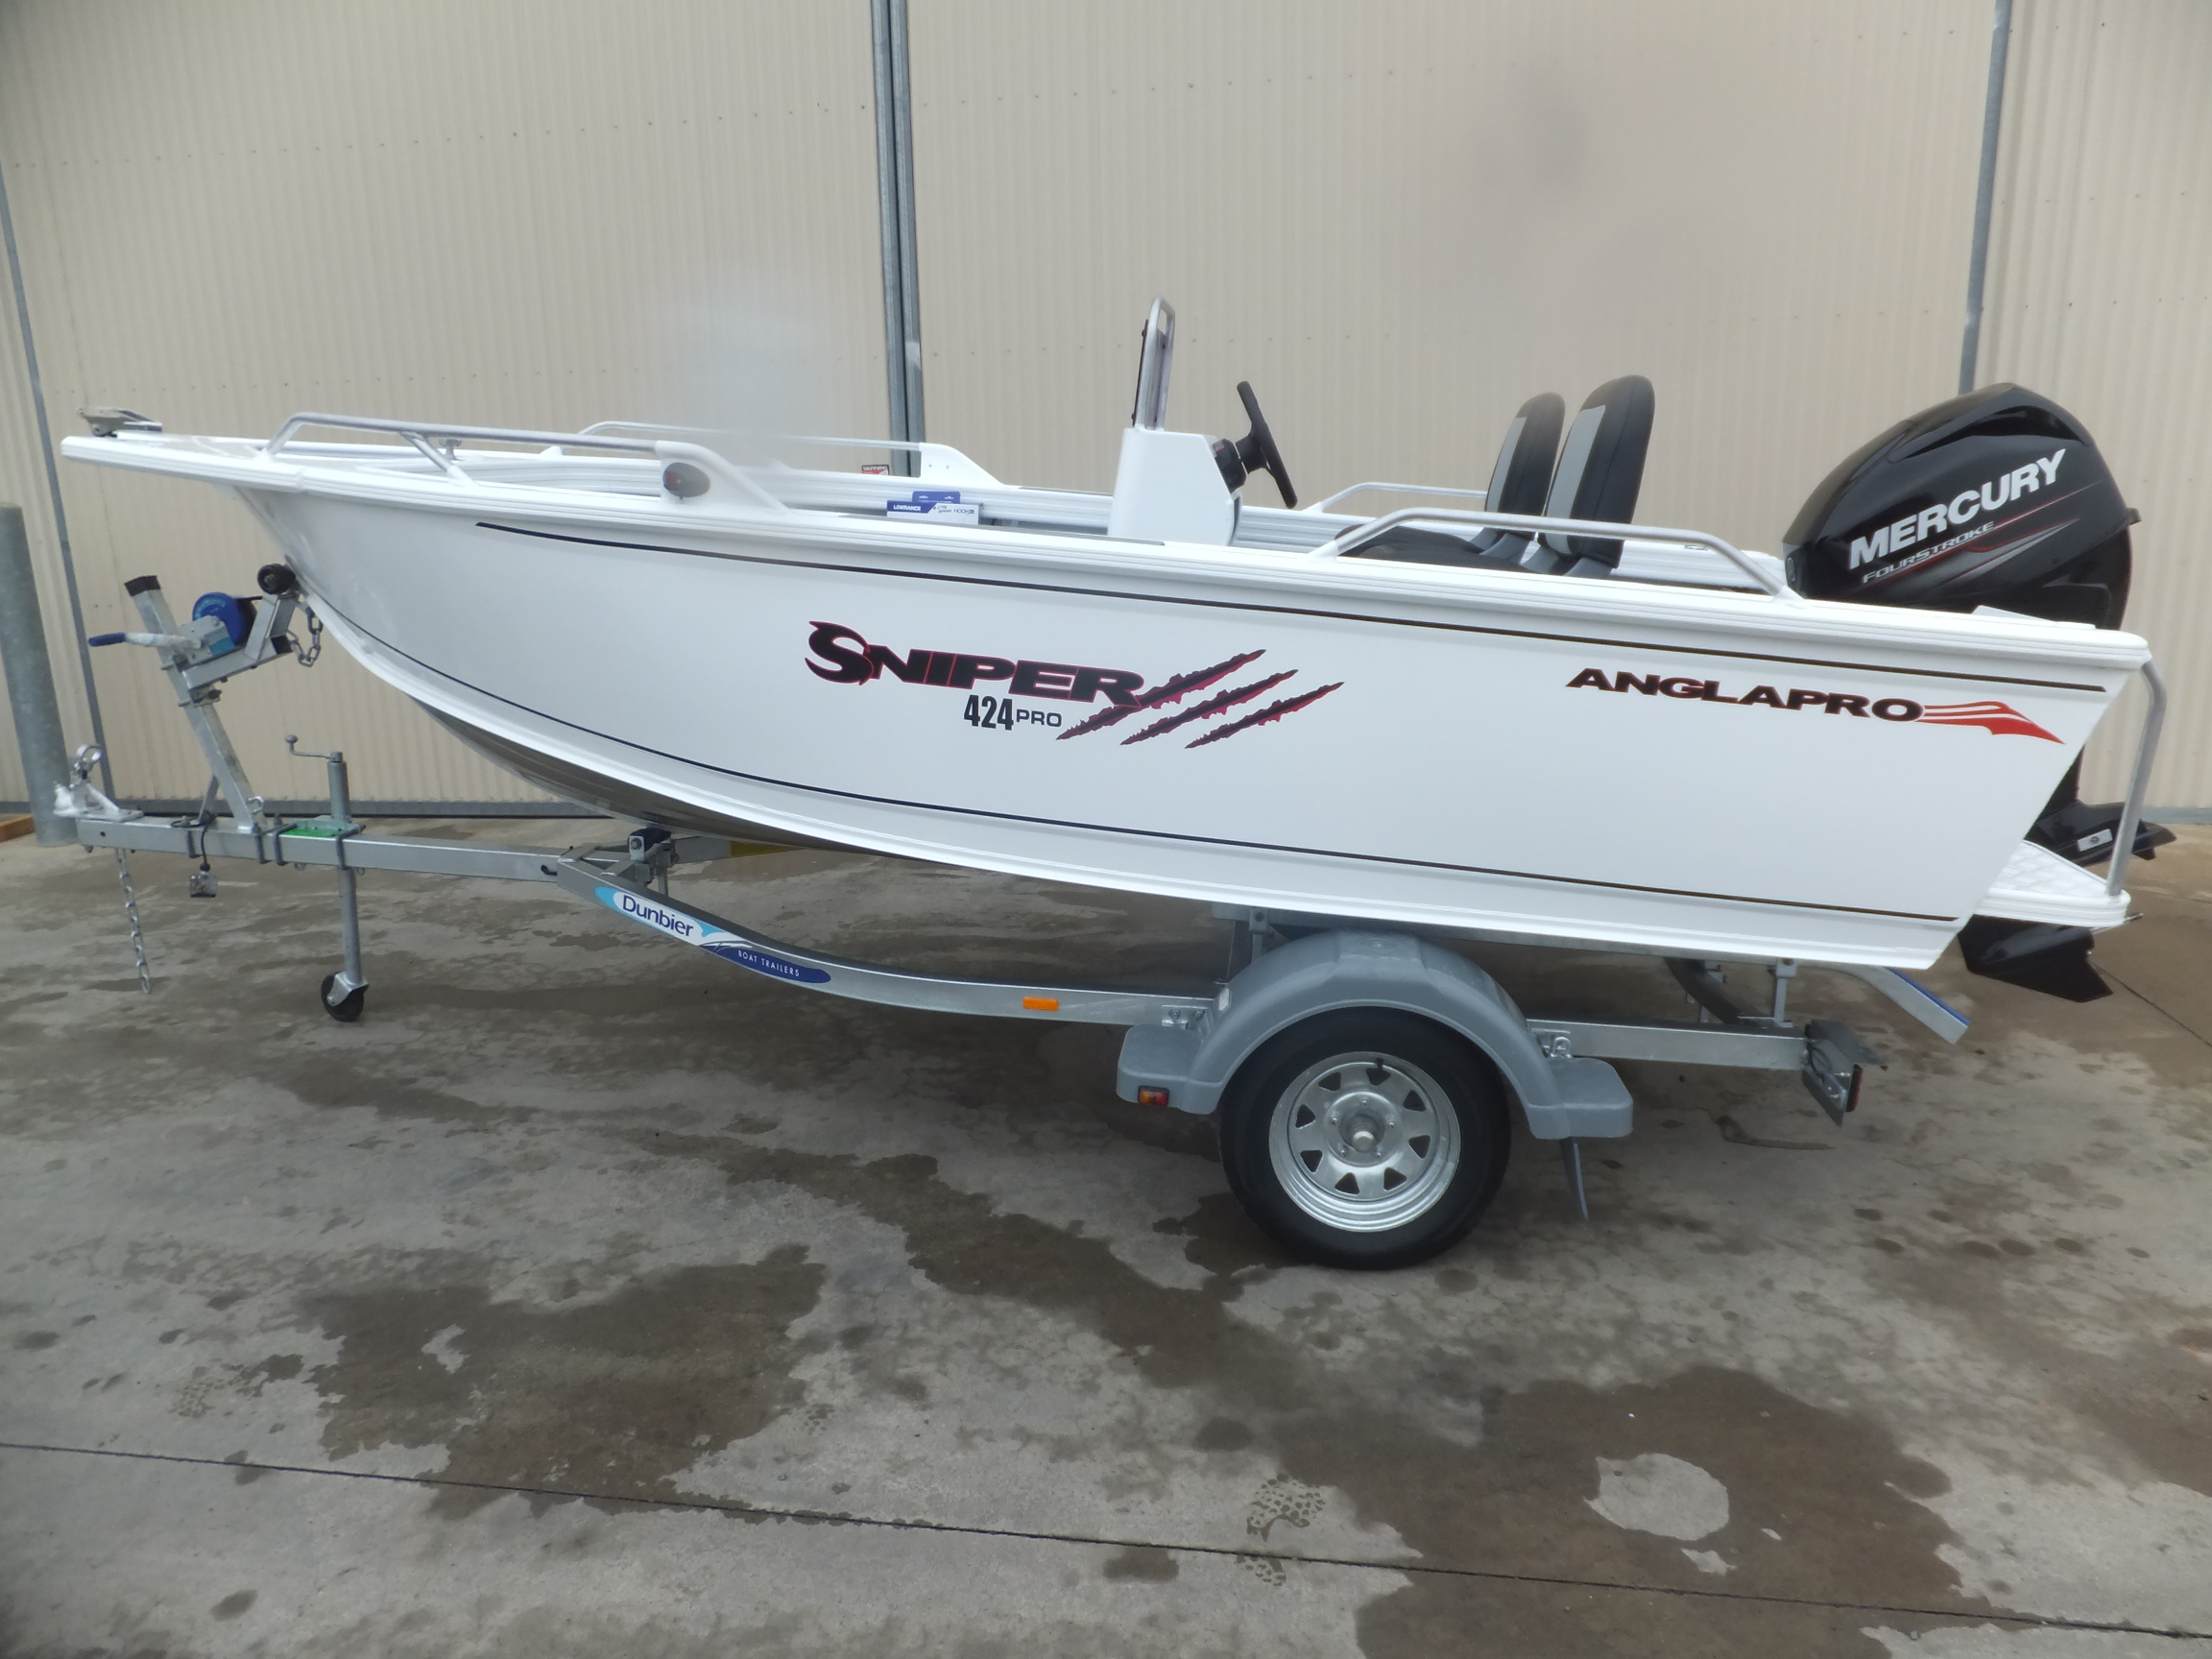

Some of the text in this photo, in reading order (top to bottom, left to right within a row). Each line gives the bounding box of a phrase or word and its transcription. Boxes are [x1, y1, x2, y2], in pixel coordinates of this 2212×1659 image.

[1848, 447, 2066, 569] MERCURY
[1862, 520, 1995, 584] FOURSTROKE
[804, 620, 1145, 709] SNIPER
[963, 694, 1063, 731] 424 PRO
[1565, 667, 1925, 723] ANGLAPRO
[622, 894, 694, 937] Dunbier
[737, 950, 800, 977] BOAT TRAILERS
